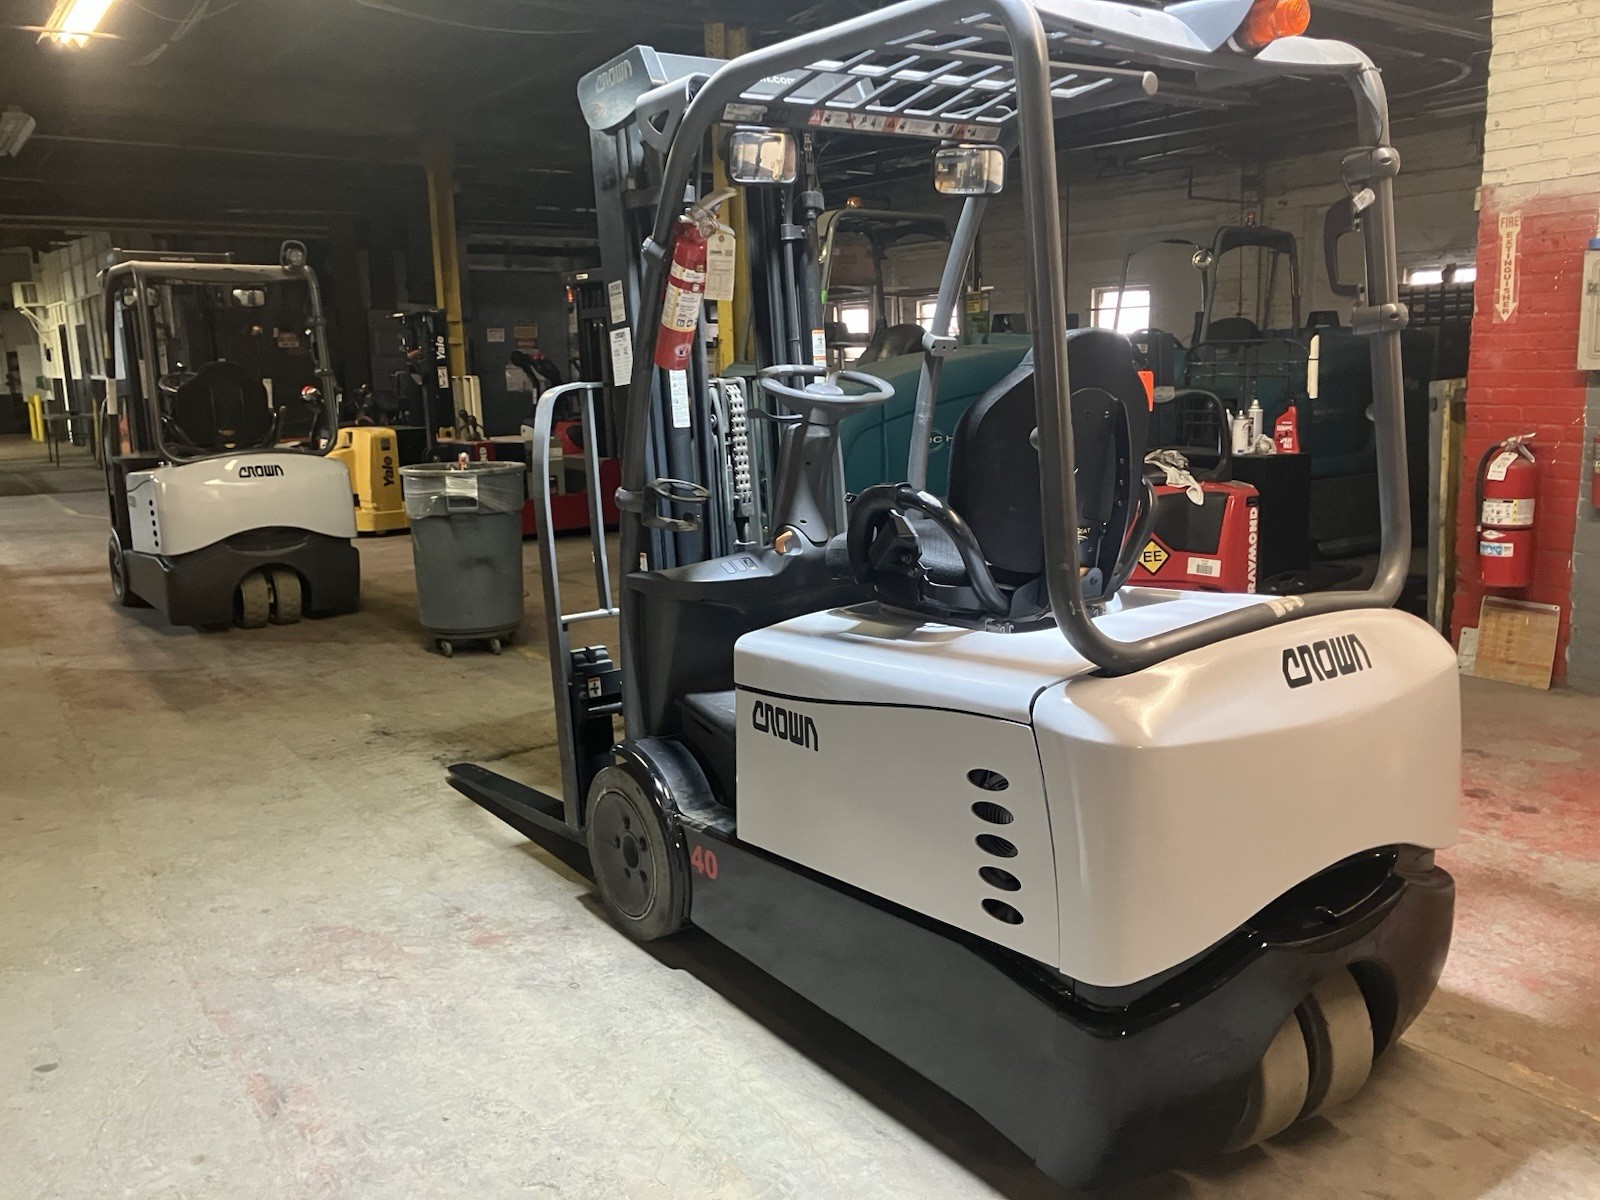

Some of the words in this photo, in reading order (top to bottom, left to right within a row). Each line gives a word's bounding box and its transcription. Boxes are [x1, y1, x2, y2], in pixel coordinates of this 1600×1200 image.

[595, 59, 633, 93] CROWN
[1500, 216, 1519, 228] FIRE
[1501, 231, 1513, 315] EXTINGUISHER
[436, 335, 446, 360] Yale
[239, 464, 285, 479] CROWN
[382, 456, 395, 487] Yale
[1143, 550, 1163, 563] EE
[1247, 506, 1260, 594] RAYMOND
[1282, 633, 1373, 689] CROWN
[752, 700, 819, 751] CROWN
[691, 844, 719, 880] 40
